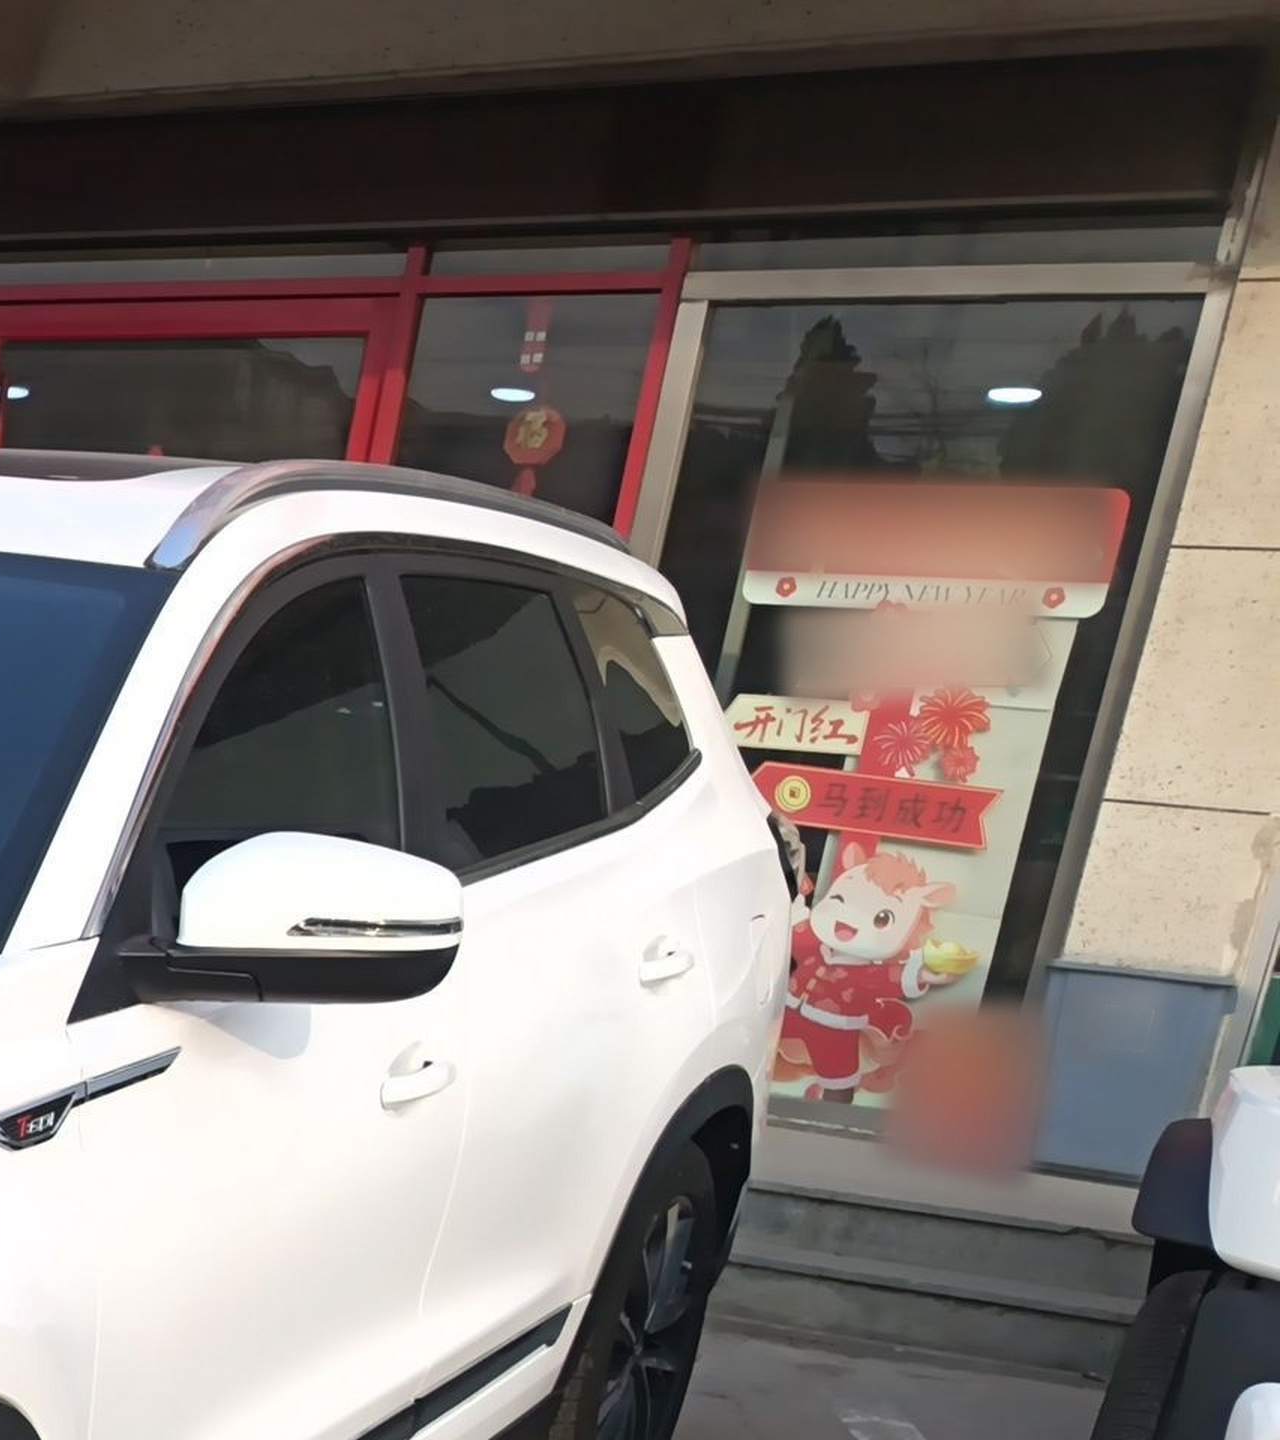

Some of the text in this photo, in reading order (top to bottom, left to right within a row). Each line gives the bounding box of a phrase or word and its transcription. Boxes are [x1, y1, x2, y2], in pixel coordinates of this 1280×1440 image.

[816, 580, 891, 600] HAPPY
[903, 583, 960, 603] NEW
[734, 705, 858, 744] 开门红
[820, 782, 967, 834] 马到成功
